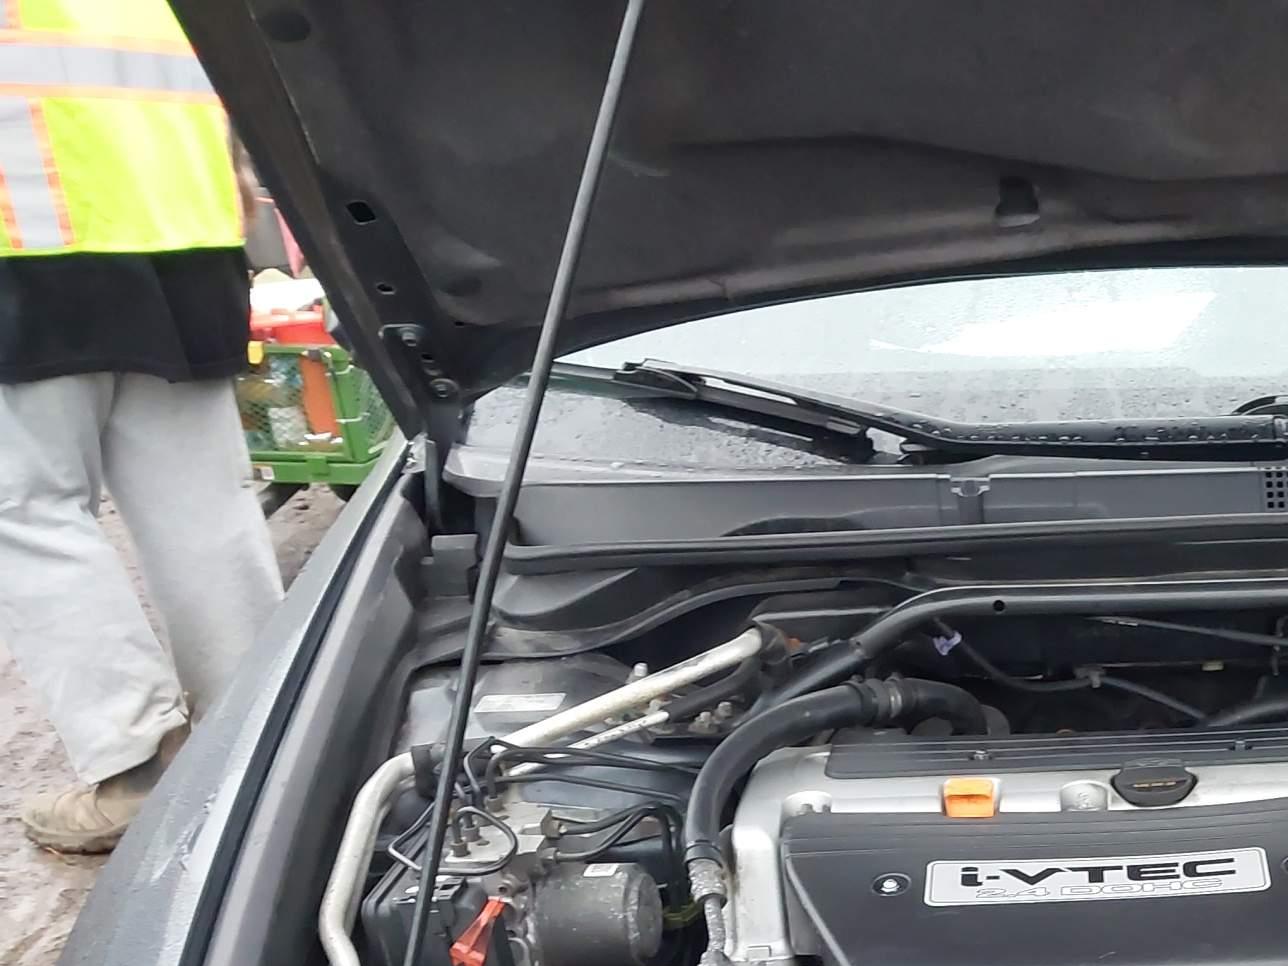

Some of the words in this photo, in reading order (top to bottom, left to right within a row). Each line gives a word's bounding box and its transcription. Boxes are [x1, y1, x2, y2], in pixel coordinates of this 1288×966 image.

[961, 857, 1237, 888] i-VTEC
[975, 885, 1051, 899] 2.4
[1060, 878, 1223, 897] DOHC
